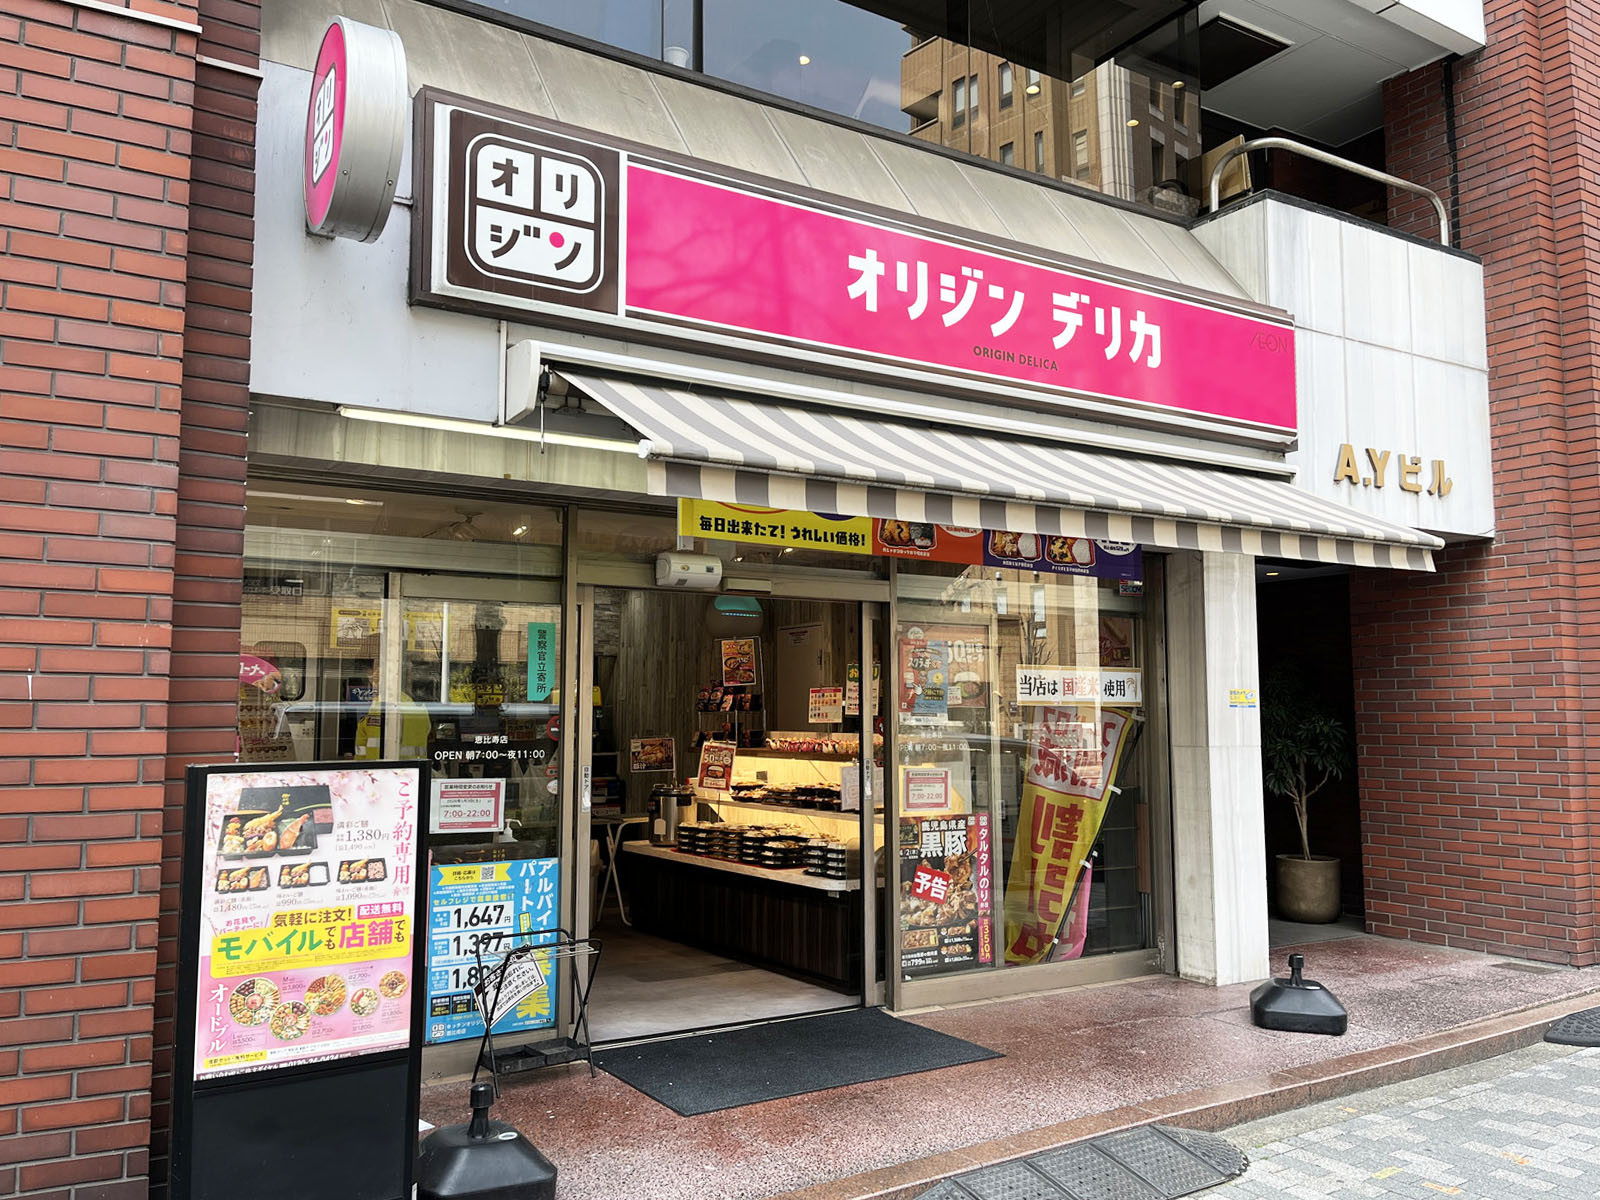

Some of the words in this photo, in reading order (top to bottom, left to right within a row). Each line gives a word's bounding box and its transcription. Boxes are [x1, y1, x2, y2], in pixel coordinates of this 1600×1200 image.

[847, 248, 1025, 338] オリジン
[1052, 291, 1161, 369] デリカ
[973, 345, 1015, 363] ORIGIN
[1019, 353, 1058, 372] DELICA
[536, 629, 548, 694] 警察官立寄所
[474, 735, 509, 745] 恵比寿店
[434, 751, 463, 760] OPEN
[392, 778, 413, 885] ご予約専用
[921, 819, 967, 832] 鹿児島県産
[920, 829, 968, 859] 黒豚
[914, 871, 948, 900] 予告
[358, 903, 402, 916] 配送無料
[208, 983, 229, 1056] オードブル
